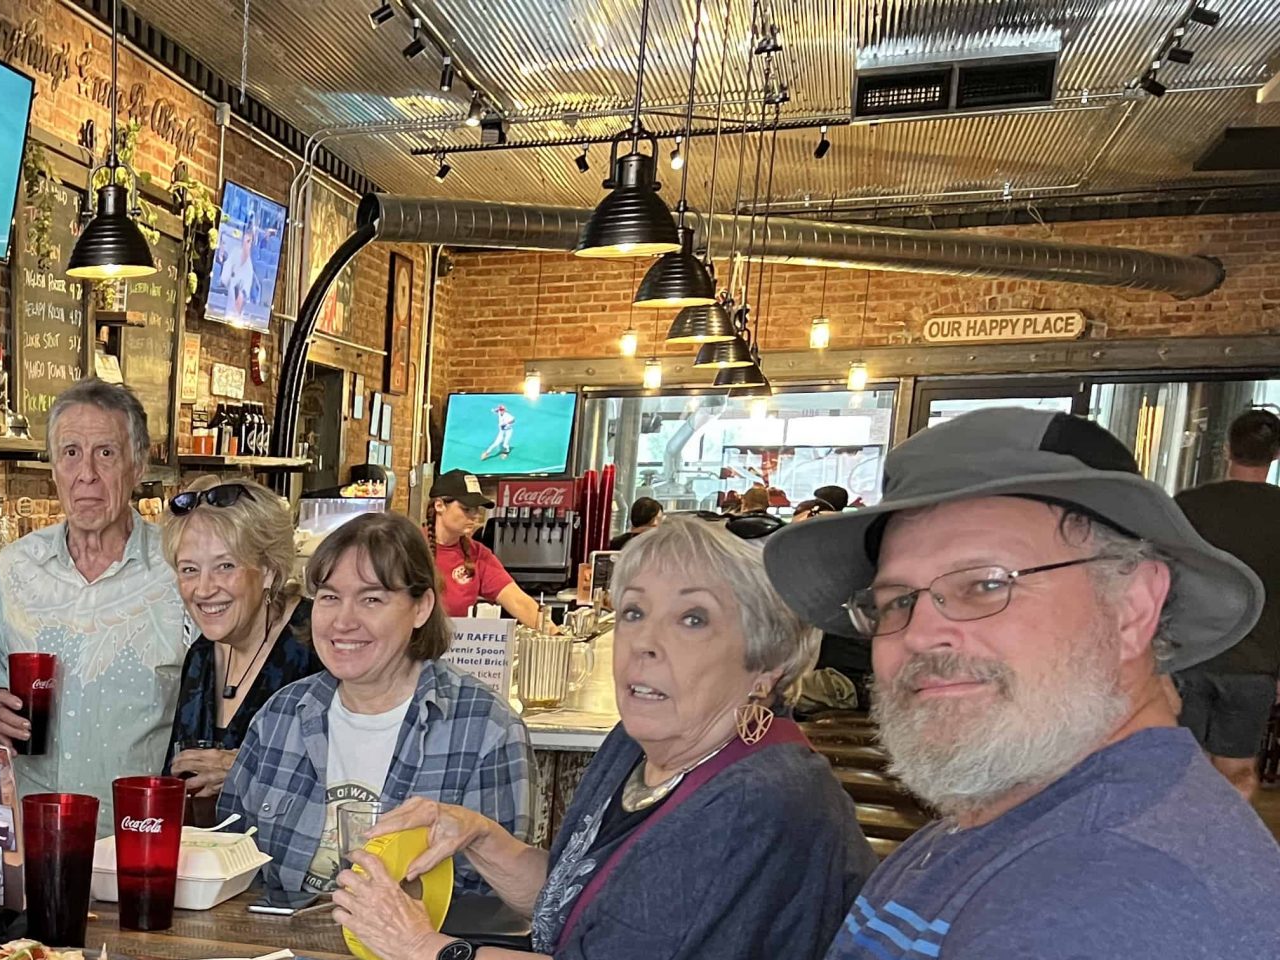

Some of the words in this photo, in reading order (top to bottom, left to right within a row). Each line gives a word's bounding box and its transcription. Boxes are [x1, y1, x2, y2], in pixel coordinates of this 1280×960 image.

[928, 320, 961, 338] OUR
[966, 317, 1020, 337] HAPPY
[1022, 315, 1076, 334] PLACE
[512, 486, 567, 505] Coca-Cola
[467, 633, 508, 643] RAFFLE
[476, 647, 505, 655] Spoon
[457, 657, 482, 665] Hotel
[477, 671, 501, 679] ticket
[121, 815, 164, 833] Coca-Cola
